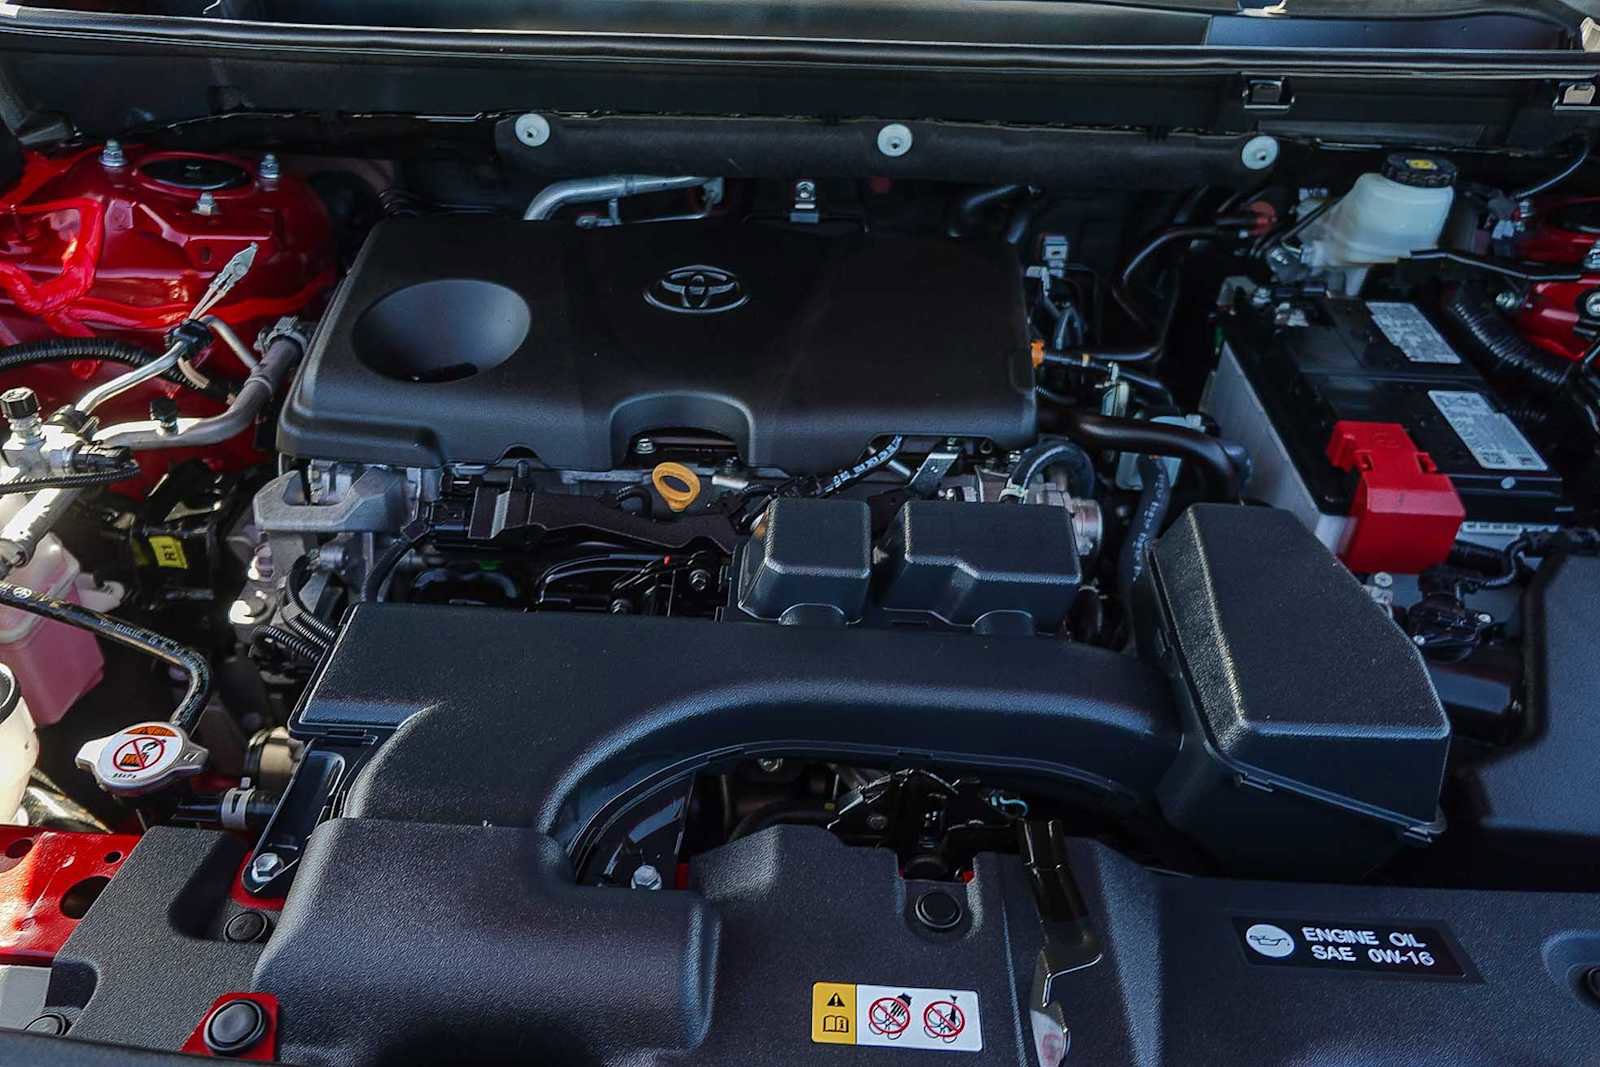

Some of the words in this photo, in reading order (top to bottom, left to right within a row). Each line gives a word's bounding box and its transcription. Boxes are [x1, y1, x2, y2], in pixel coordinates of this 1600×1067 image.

[1301, 926, 1380, 946] ENGINE
[1389, 932, 1427, 948] OIL
[1311, 945, 1357, 962] SAE
[1367, 948, 1436, 967] 0W-16
